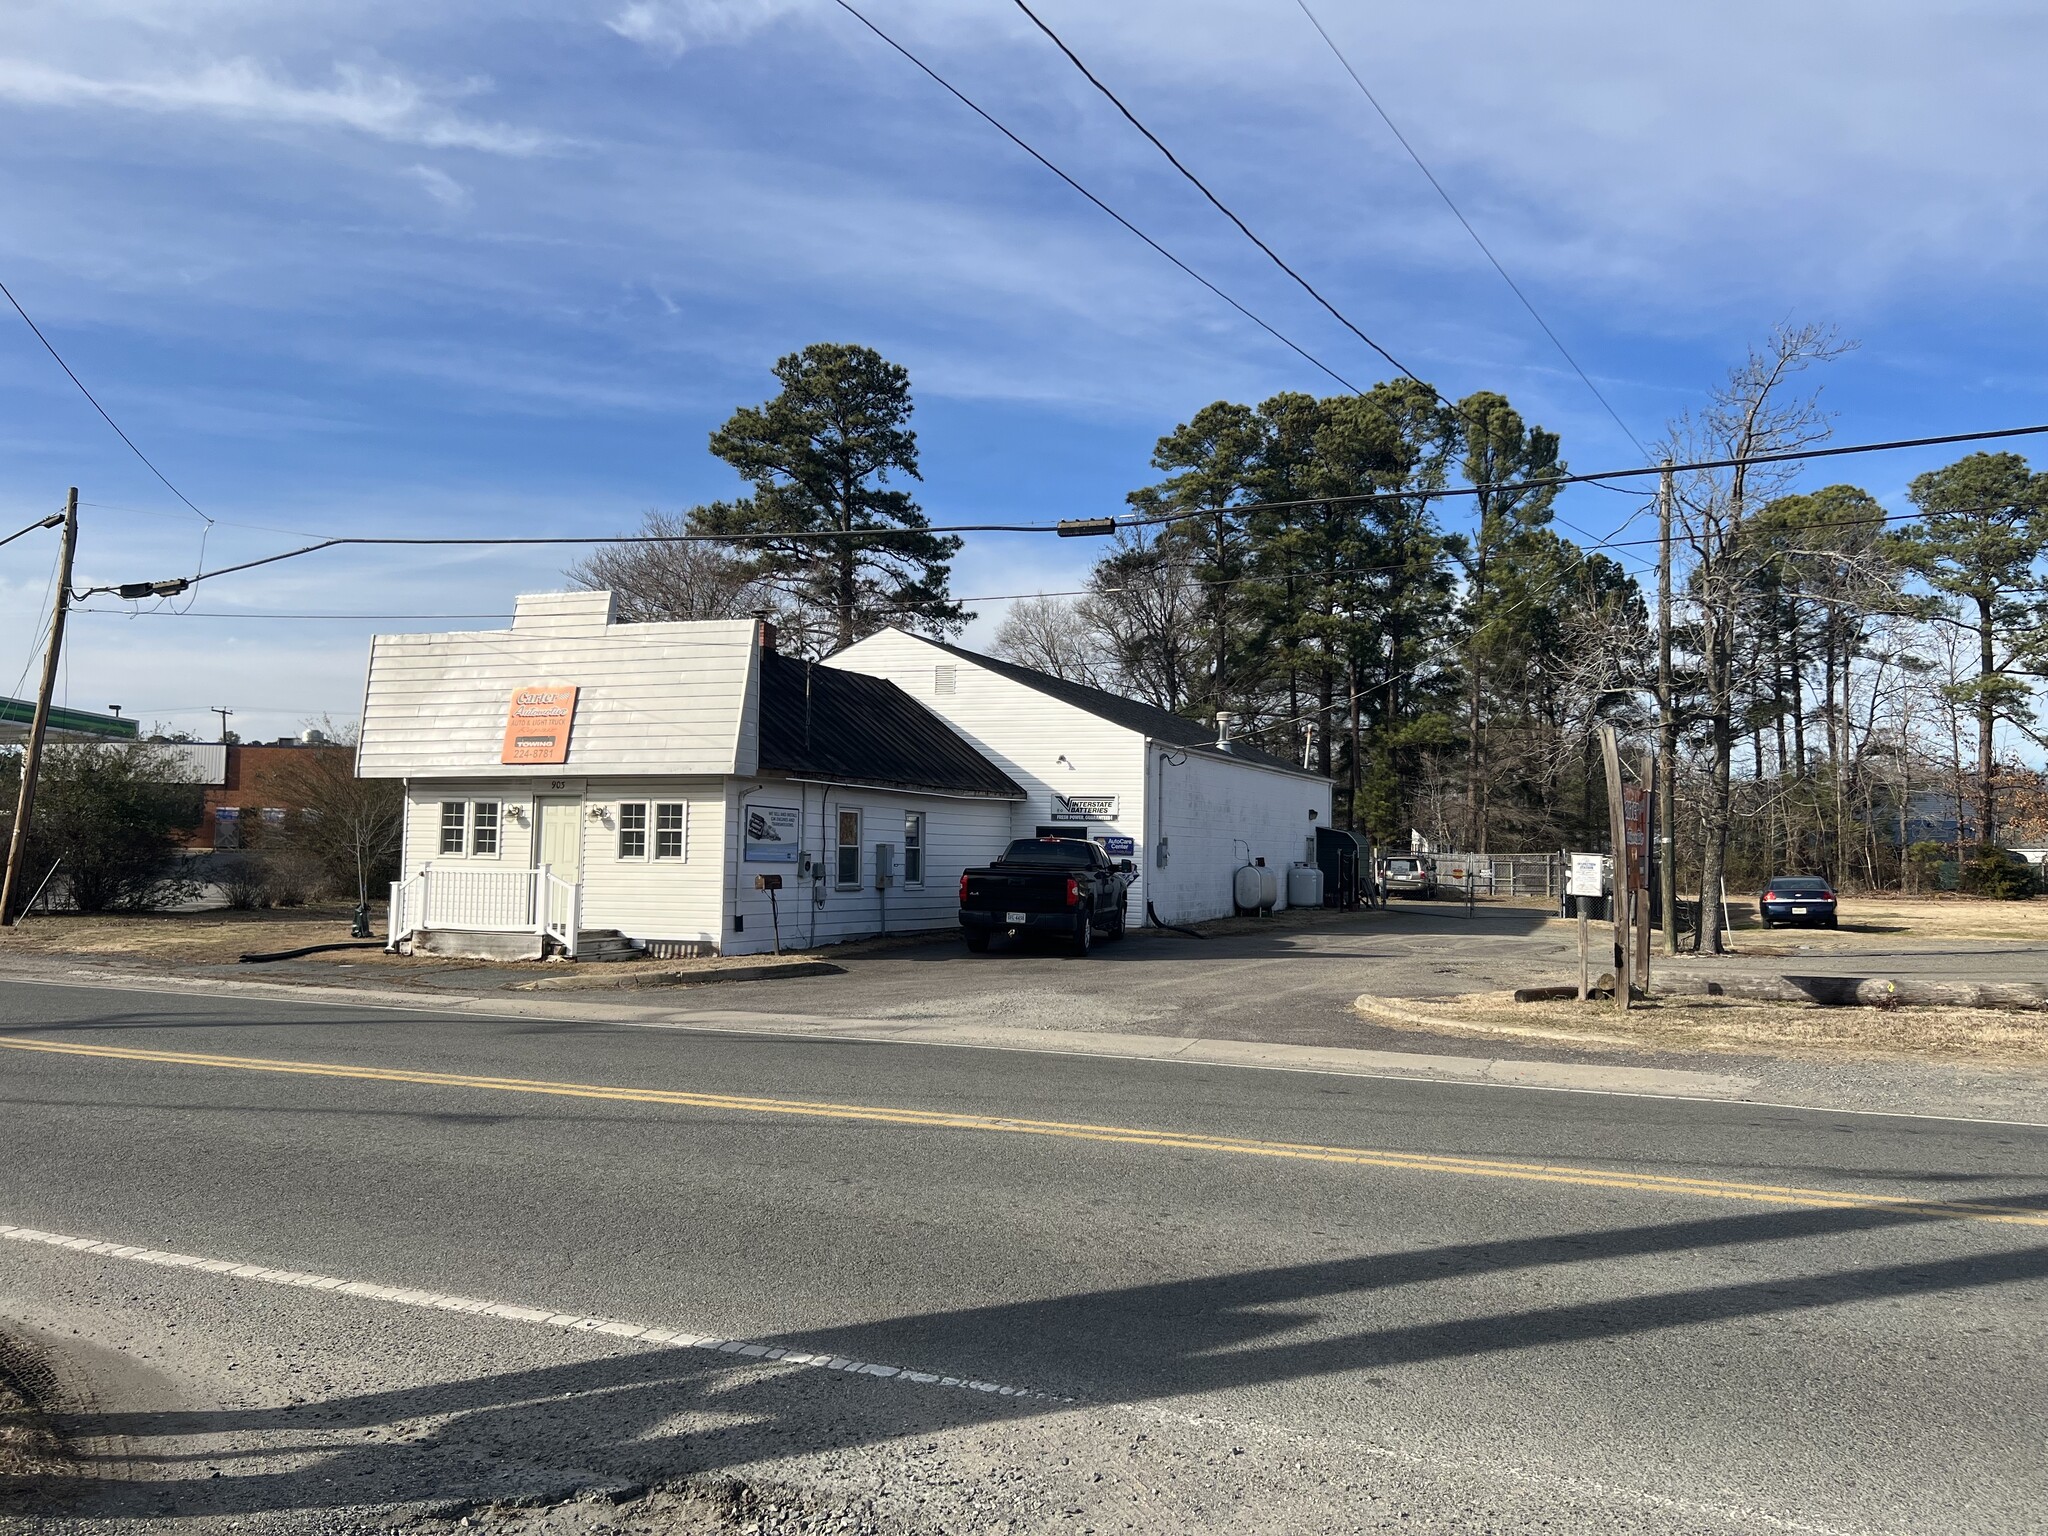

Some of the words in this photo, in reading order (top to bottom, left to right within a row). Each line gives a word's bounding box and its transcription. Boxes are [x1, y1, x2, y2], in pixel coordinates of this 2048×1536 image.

[517, 691, 558, 705] Carter
[512, 705, 568, 718] Automotive
[513, 749, 554, 758] 224-8781
